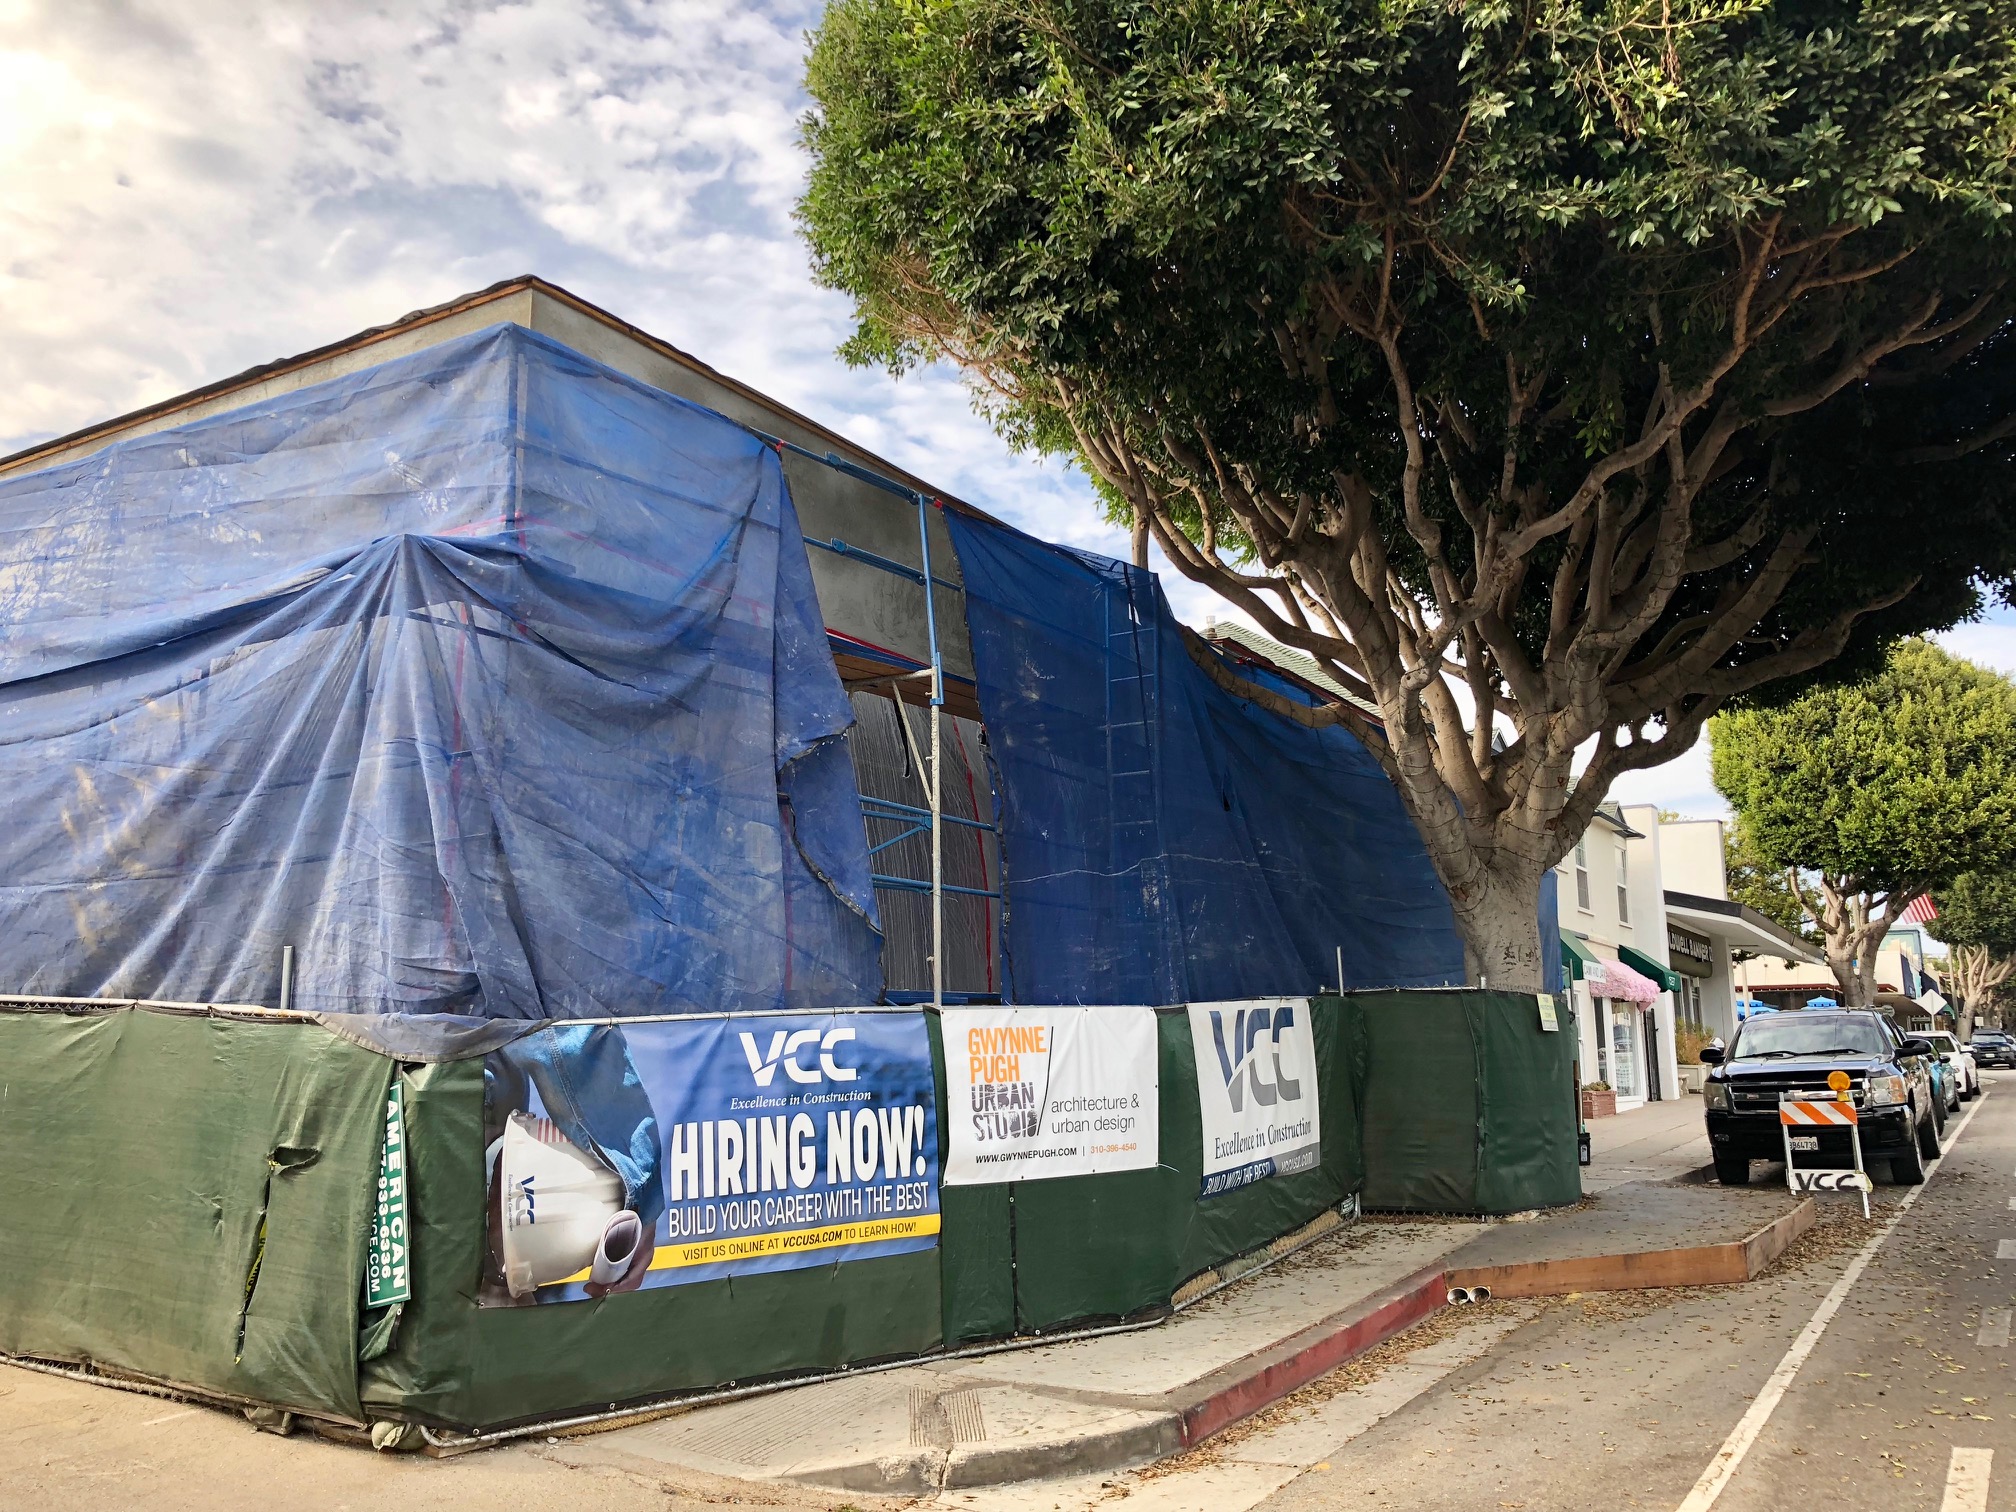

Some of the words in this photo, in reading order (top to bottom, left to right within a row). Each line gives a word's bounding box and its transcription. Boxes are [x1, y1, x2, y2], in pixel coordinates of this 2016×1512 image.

[968, 1026, 1047, 1055] GWYNNE
[738, 1028, 857, 1087] VCC
[969, 1054, 1021, 1084] PUGH
[1208, 1006, 1301, 1114] VCC
[730, 1095, 787, 1111] Excellence
[790, 1094, 800, 1106] in
[803, 1090, 872, 1105] Construction
[971, 1081, 1035, 1113] URBAN
[1051, 1095, 1128, 1113] architecture
[1130, 1093, 1140, 1109] &
[972, 1109, 1039, 1142] STUDIO
[1051, 1117, 1090, 1135] urban
[1093, 1114, 1135, 1133] design
[1214, 1131, 1255, 1160] Excellence
[1256, 1127, 1266, 1148] in
[1267, 1117, 1312, 1146] Construction
[670, 1112, 817, 1202] HIRING
[826, 1104, 927, 1185] NOW!
[975, 1147, 1077, 1164] WWW.GWYNNEPUGH.COM
[1090, 1142, 1137, 1154] 310-396-4540
[386, 1100, 405, 1289] AMERICAN
[1795, 1172, 1862, 1192] VCC
[515, 1175, 535, 1226] VCC
[668, 1204, 716, 1238] BUILD
[719, 1199, 762, 1232] YOUR
[765, 1193, 823, 1226] CAREER
[825, 1187, 862, 1219] WITH
[865, 1184, 892, 1214] THE
[896, 1181, 929, 1211] BEST
[682, 1246, 709, 1261] VISIT
[711, 1244, 726, 1257] US
[728, 1239, 765, 1255] ONLINE
[767, 1237, 780, 1250] AT
[783, 1231, 842, 1248] VCCUSA.COM
[844, 1228, 856, 1239] TO
[858, 1225, 889, 1238] LEARN
[890, 1222, 917, 1234] HOW!
